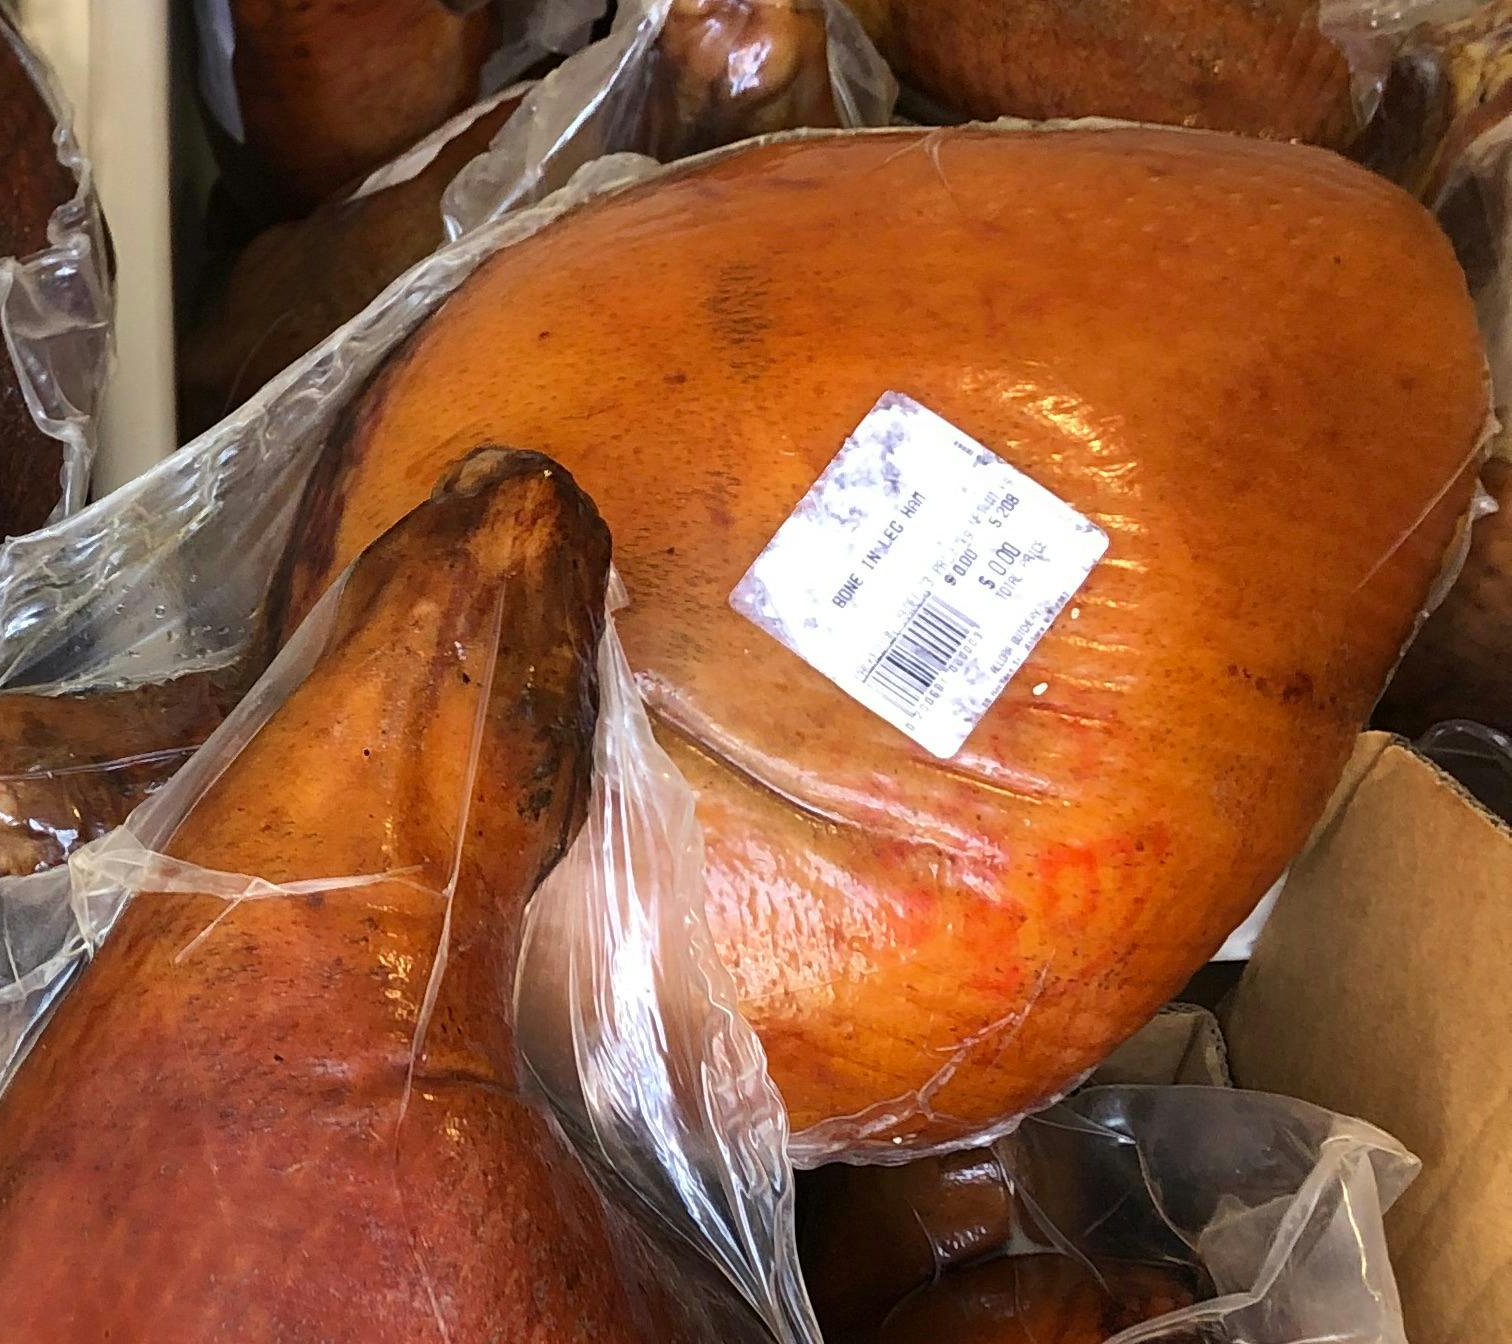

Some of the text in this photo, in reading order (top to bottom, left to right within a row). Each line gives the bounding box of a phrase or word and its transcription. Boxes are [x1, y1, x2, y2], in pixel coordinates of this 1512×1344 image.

[988, 493, 1019, 528] 5208
[832, 490, 926, 609] BONE IN LEG HAM
[988, 541, 1021, 576] 000
